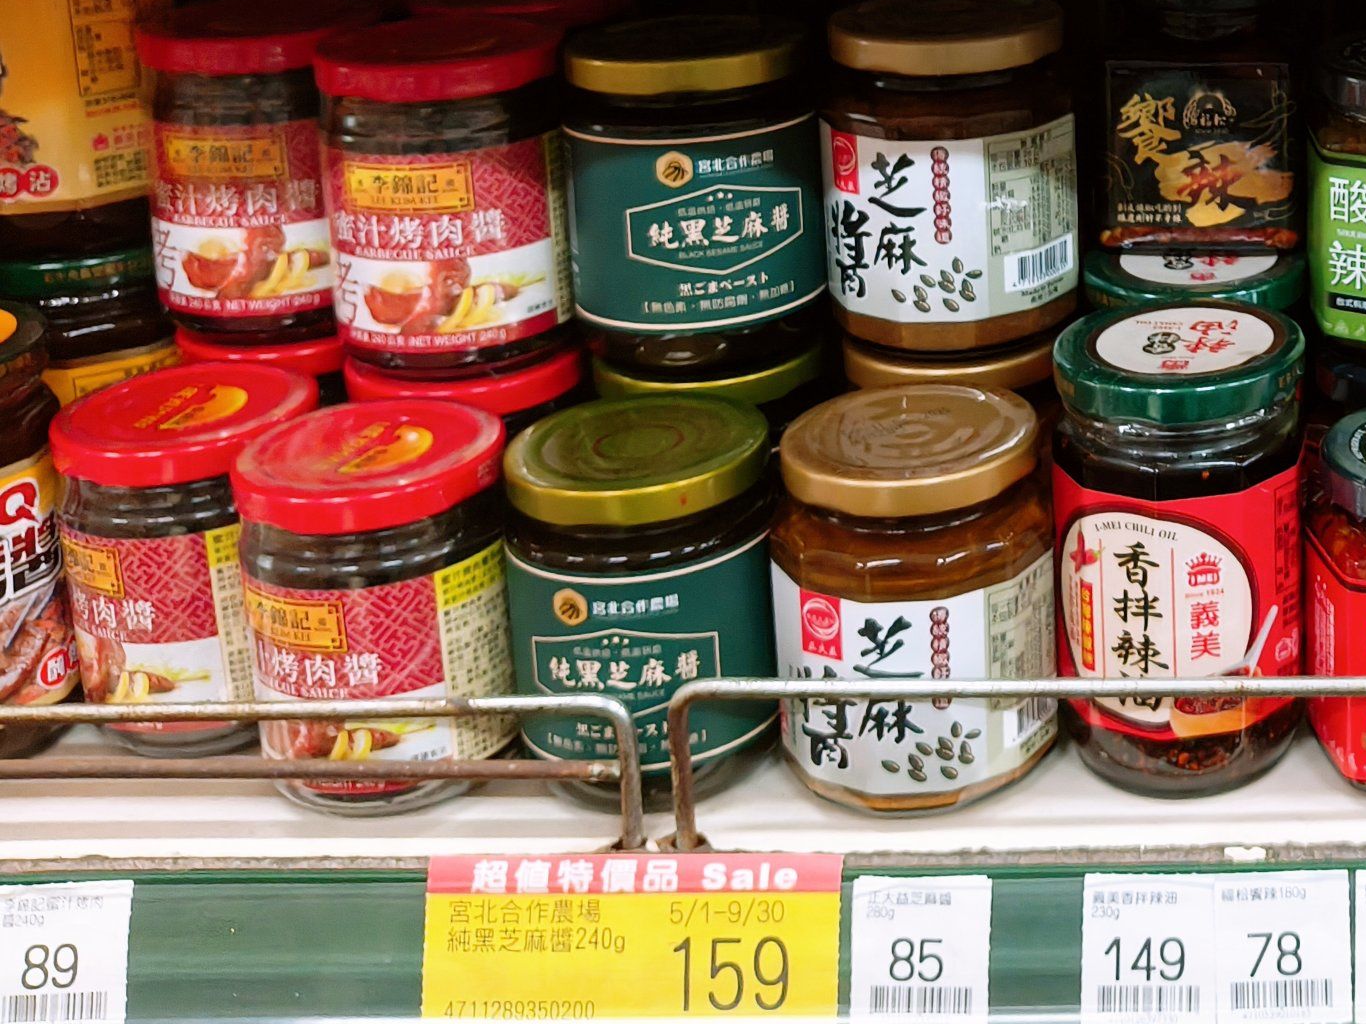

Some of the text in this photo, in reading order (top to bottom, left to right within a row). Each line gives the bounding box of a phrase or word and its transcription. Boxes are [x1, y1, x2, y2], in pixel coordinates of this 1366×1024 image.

[1190, 601, 1221, 660] 義美
[473, 859, 799, 892] 超值特價品 Sale
[449, 900, 785, 925] 宮北合作農場 5/1-9/30
[447, 928, 626, 954] 純黑芝麻醬240g
[889, 937, 945, 982] 85
[1104, 936, 1186, 982] 149
[1246, 932, 1303, 977] 78
[21, 943, 79, 989] 89
[673, 935, 790, 1012] 159
